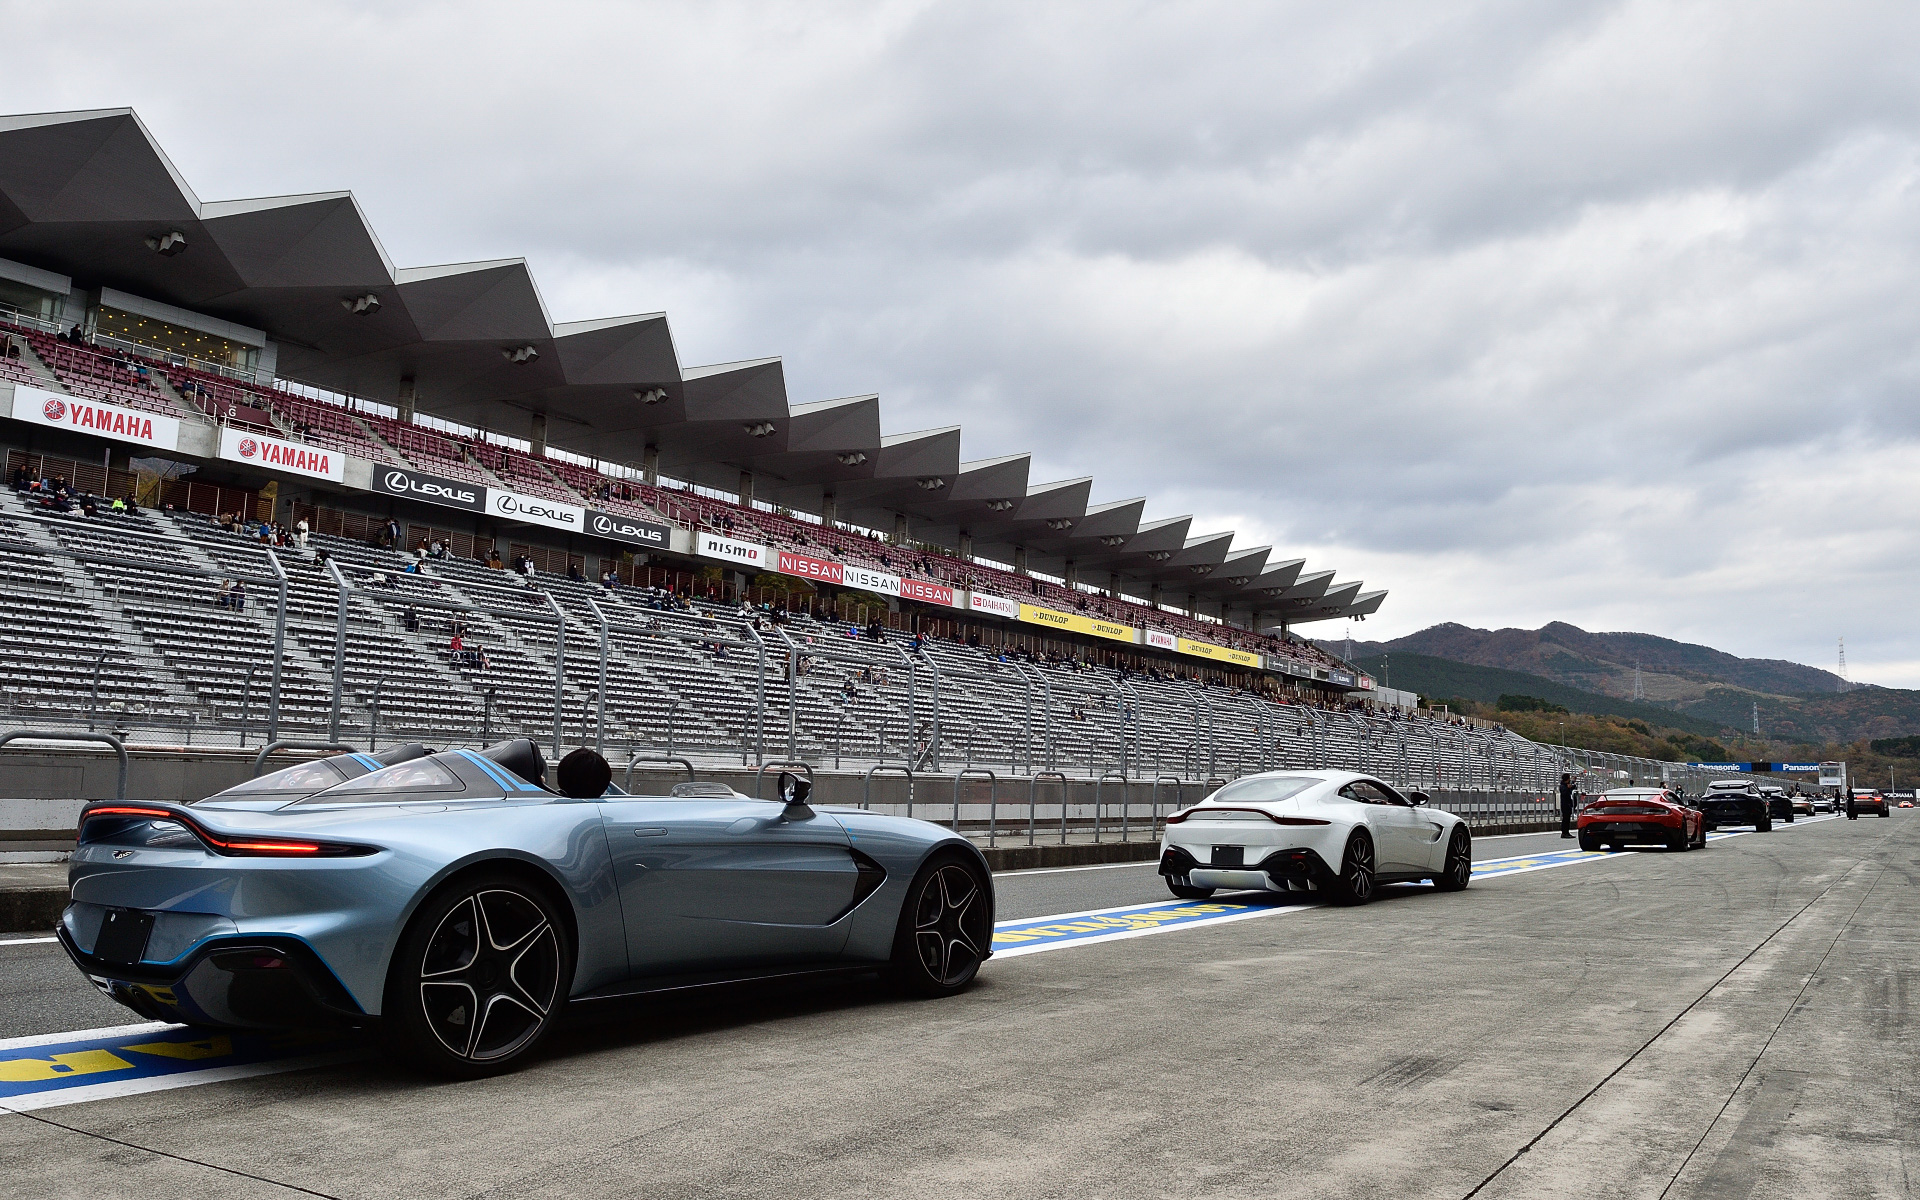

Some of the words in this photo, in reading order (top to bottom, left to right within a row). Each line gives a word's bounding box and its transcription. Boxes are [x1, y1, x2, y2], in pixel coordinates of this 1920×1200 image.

[71, 403, 153, 440] YAMAHA
[260, 441, 330, 474] YAMAHA
[410, 480, 475, 503] LEXUS
[519, 503, 575, 523] LEXUS
[612, 524, 662, 542] LEXUS
[781, 556, 842, 581] NISSAN
[845, 570, 899, 592] NISSAN
[901, 581, 952, 603] NISSAN
[982, 598, 1013, 613] DAIHATSU
[1038, 612, 1069, 624] DUNLOP
[1096, 624, 1123, 636] DUNLOP
[1782, 763, 1819, 771] Panason
